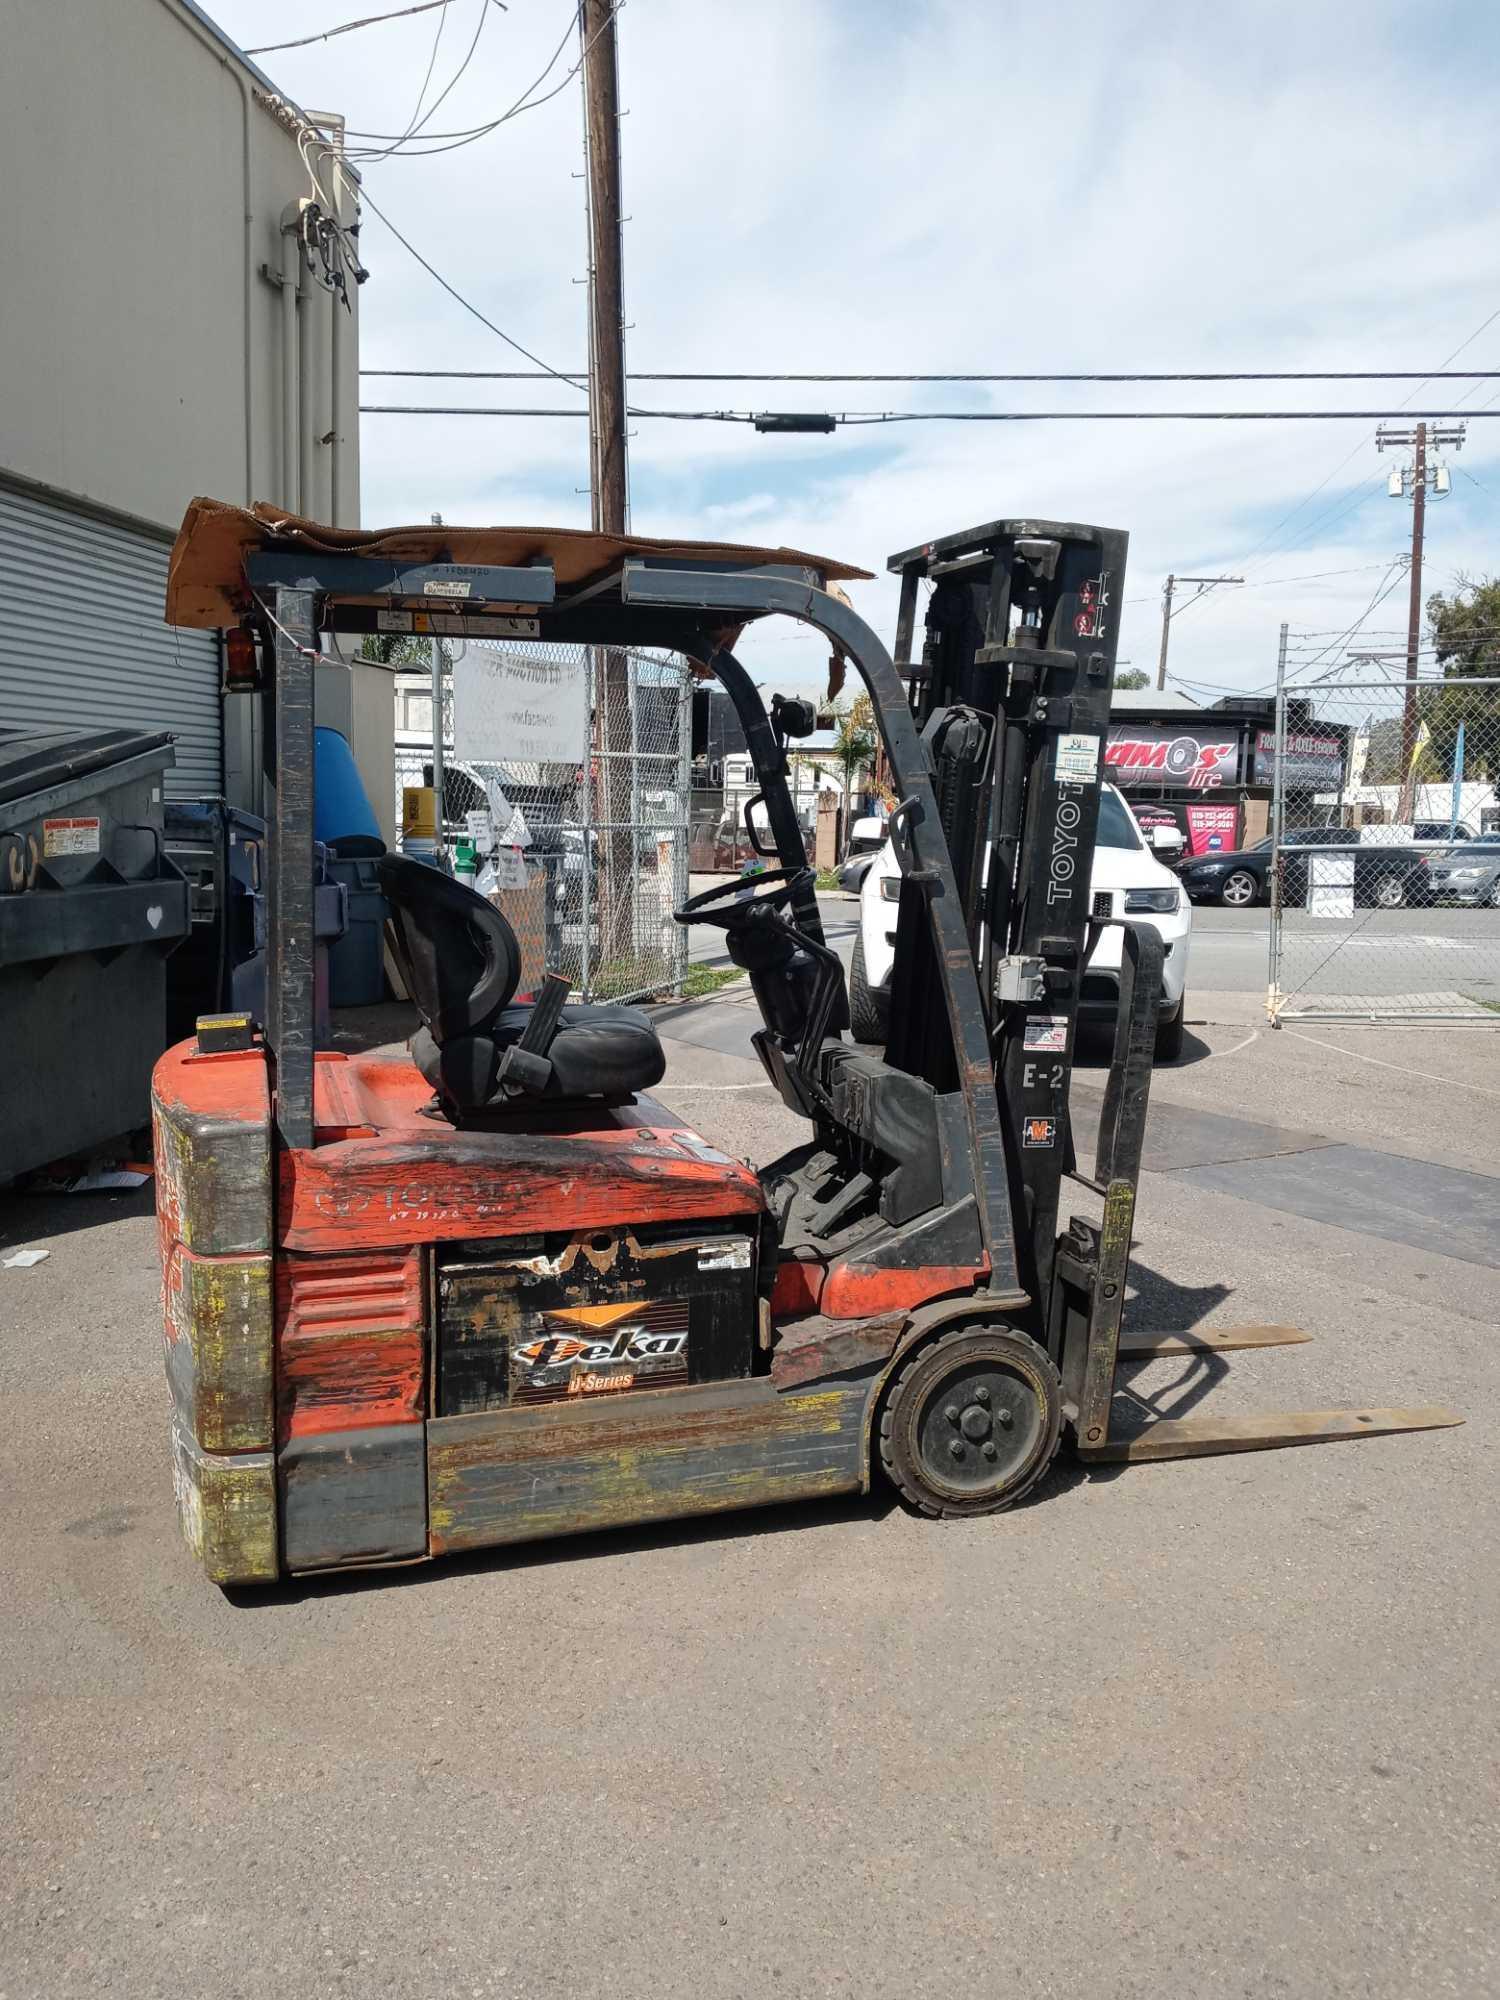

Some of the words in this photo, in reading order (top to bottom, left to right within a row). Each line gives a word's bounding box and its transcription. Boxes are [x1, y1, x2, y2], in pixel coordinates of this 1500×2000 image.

[1105, 737, 1235, 773] AMOS'
[1047, 780, 1085, 905] TOYOT
[1023, 1063, 1064, 1088] E-2
[514, 1328, 686, 1367] Deka
